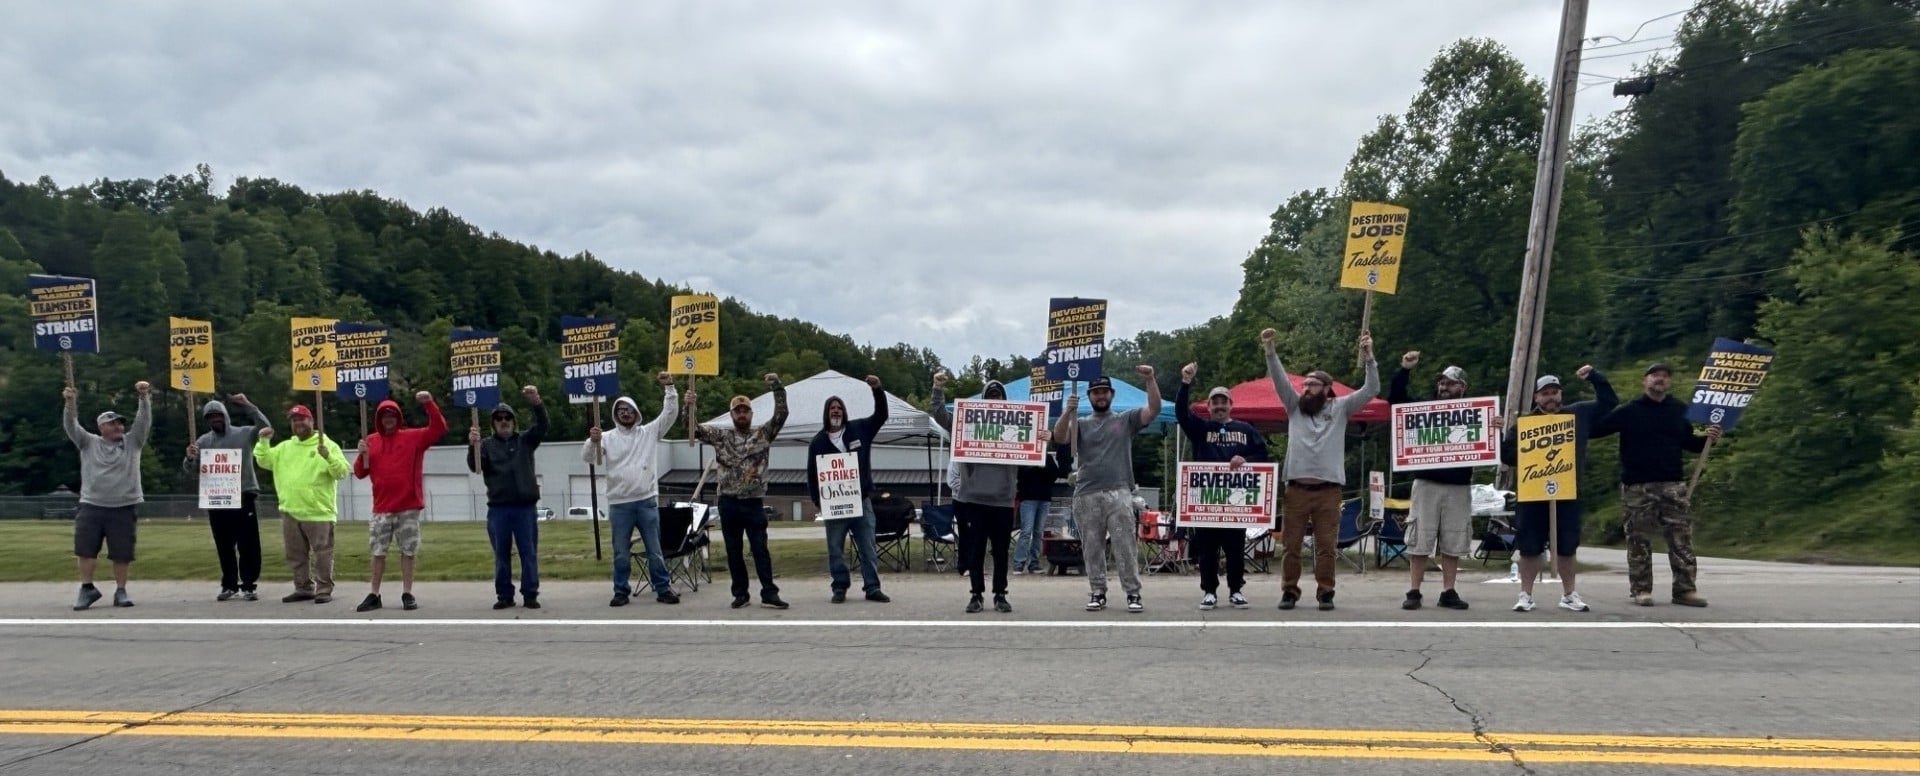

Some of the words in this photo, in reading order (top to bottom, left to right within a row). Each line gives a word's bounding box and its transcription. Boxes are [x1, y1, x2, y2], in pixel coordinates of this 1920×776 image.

[1353, 213, 1406, 226] DESTROYING
[1350, 224, 1405, 238] JOBS
[1347, 250, 1398, 268] Tasteless
[34, 299, 91, 313] TEAMSTERS
[1050, 304, 1105, 318] BEVERAGE
[672, 311, 715, 329] JOBS
[1055, 312, 1099, 324] MARKET
[36, 319, 93, 335] STRIKE!
[563, 323, 615, 336] BEVERAGE
[1051, 322, 1104, 339] TEAMSTERS
[171, 335, 208, 346] JOBS
[568, 331, 610, 342] MARKET
[1074, 337, 1092, 345] ULP
[337, 346, 387, 360] TEAMSTERS
[564, 340, 615, 356] TEAMSTERS
[671, 337, 714, 356] Tasteless
[1048, 343, 1102, 364] STRIKE!
[564, 360, 617, 379] STRIKE!
[1713, 359, 1765, 369] MARKET
[337, 366, 387, 383] STRIKE!
[1702, 368, 1764, 384] TEAMSTERS
[1400, 405, 1432, 413] SHAME
[965, 409, 1033, 426] BEVERAGE
[1405, 408, 1482, 429] BEVERAGE
[974, 423, 1032, 442] MARET
[1417, 423, 1482, 446] MARET
[1520, 430, 1574, 453] JOBS
[215, 453, 228, 463] ON
[831, 458, 844, 469] ON
[201, 464, 240, 473] STRIKE!
[820, 469, 858, 481] STRIKE!
[1522, 458, 1573, 483] Tasteless
[1190, 472, 1260, 488] BEVERAGE
[1200, 487, 1260, 505] MARET
